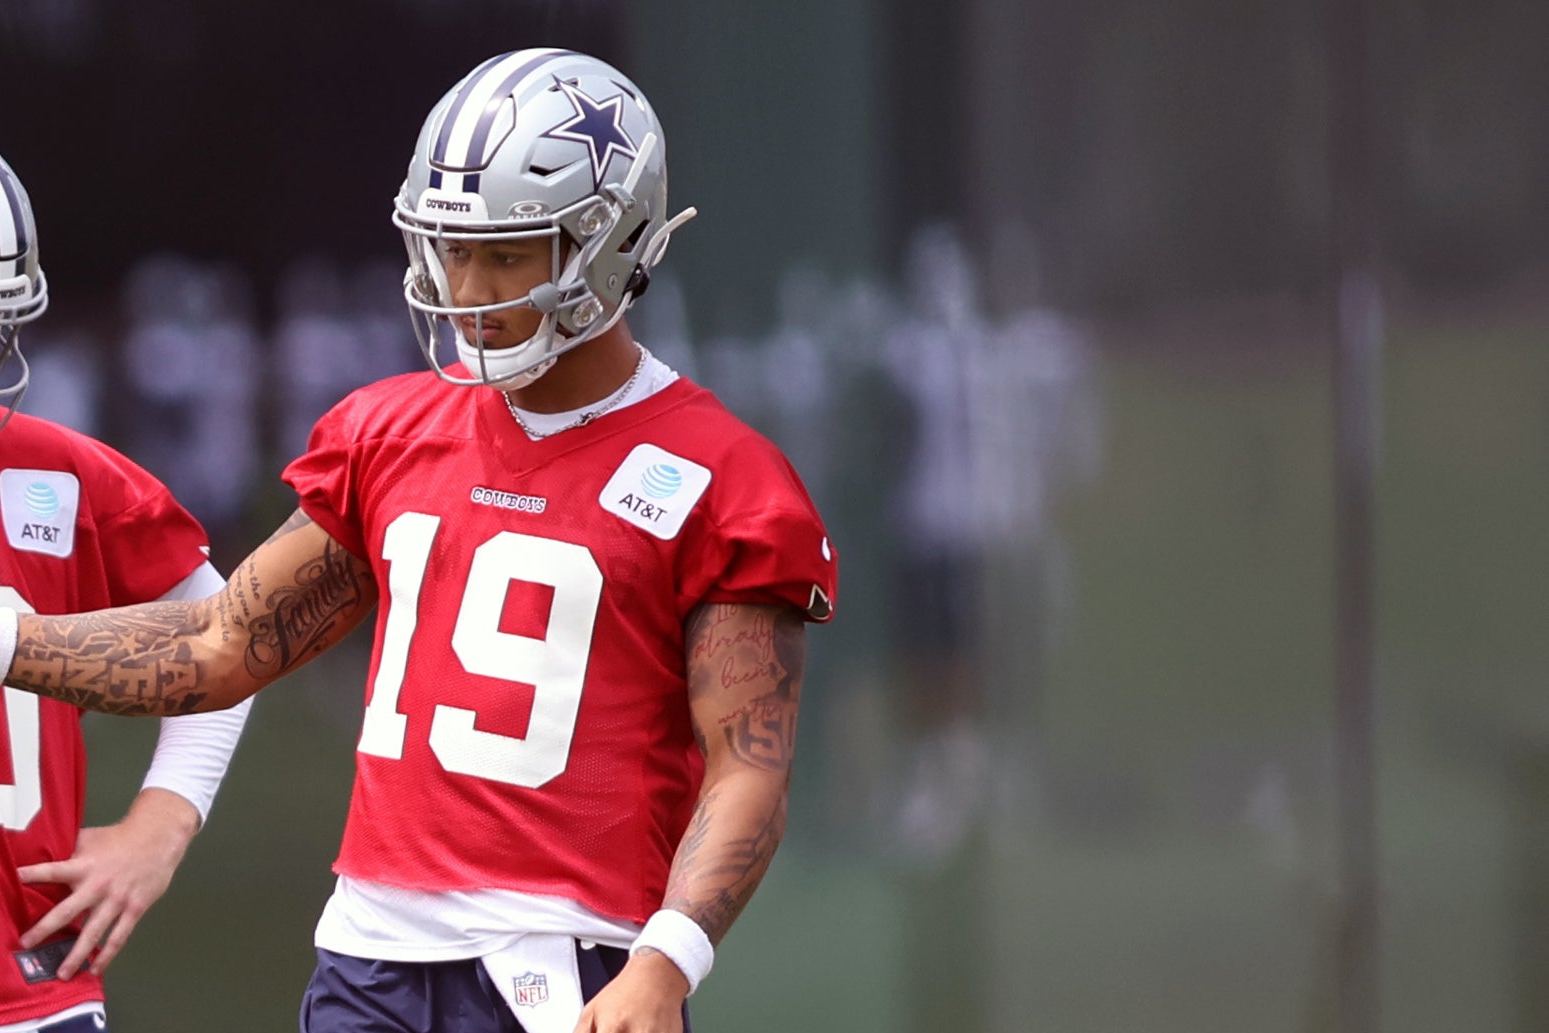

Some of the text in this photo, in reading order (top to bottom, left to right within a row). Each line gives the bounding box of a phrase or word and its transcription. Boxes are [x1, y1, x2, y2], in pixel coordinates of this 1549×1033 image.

[426, 198, 471, 212] COWBOYS
[471, 486, 547, 514] COWBOYS
[619, 493, 667, 523] AT&T
[21, 523, 61, 544] AT&T
[356, 511, 604, 789] 19
[721, 656, 770, 689] been
[517, 986, 547, 1004] NFL
